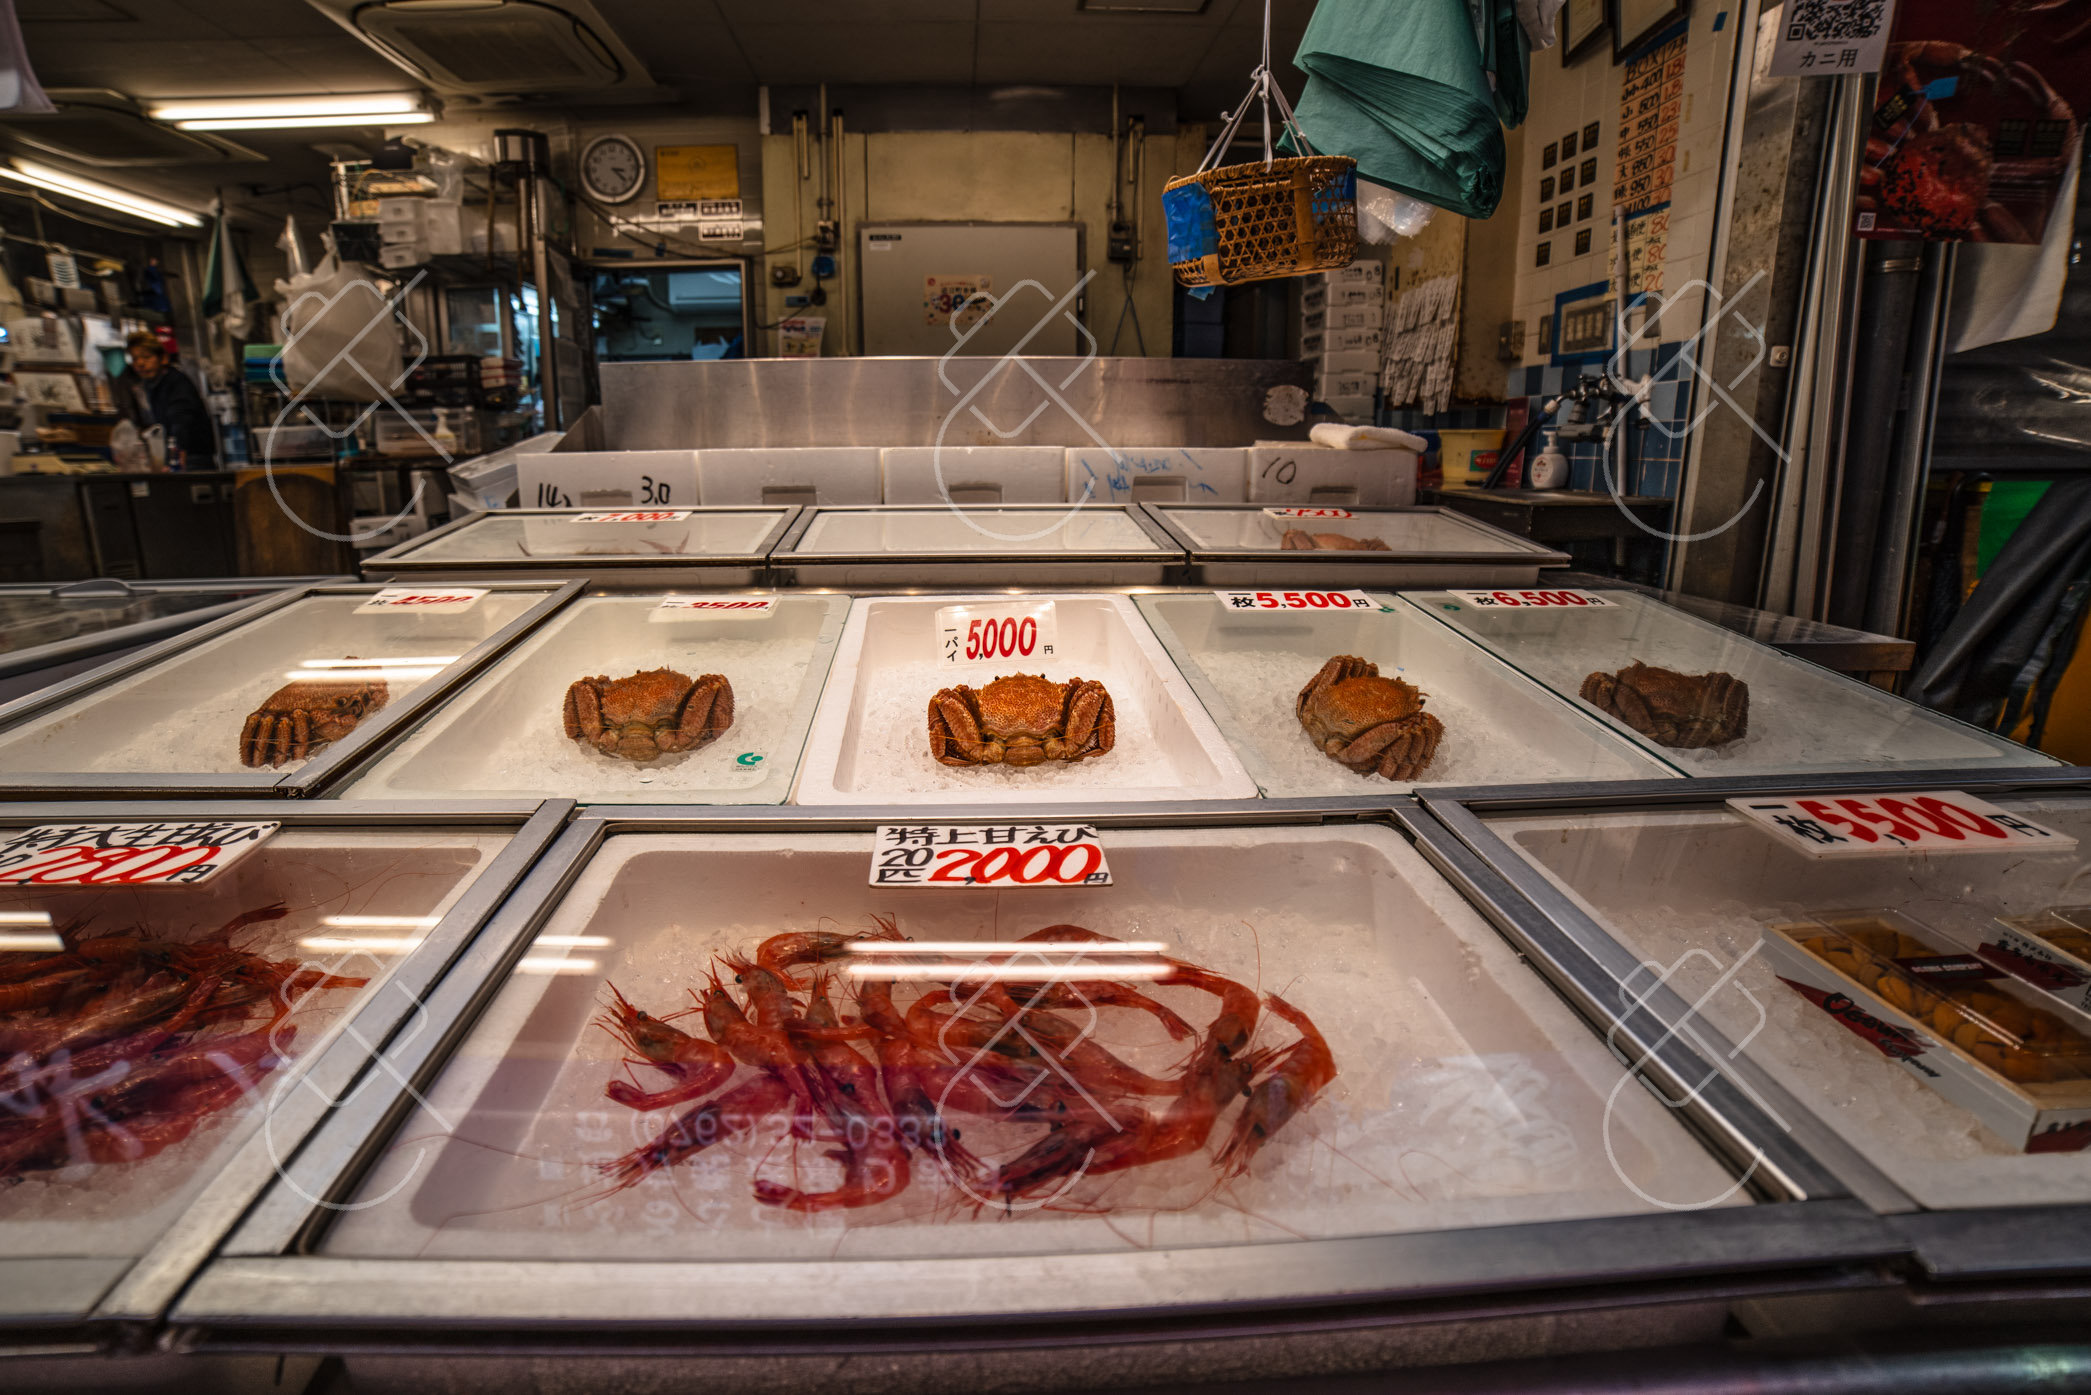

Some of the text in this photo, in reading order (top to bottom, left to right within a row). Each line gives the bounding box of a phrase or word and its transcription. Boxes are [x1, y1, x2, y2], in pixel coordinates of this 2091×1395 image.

[1800, 48, 1858, 68] カニ用
[1262, 456, 1297, 485] 10
[885, 825, 1099, 847] 特上甘えび
